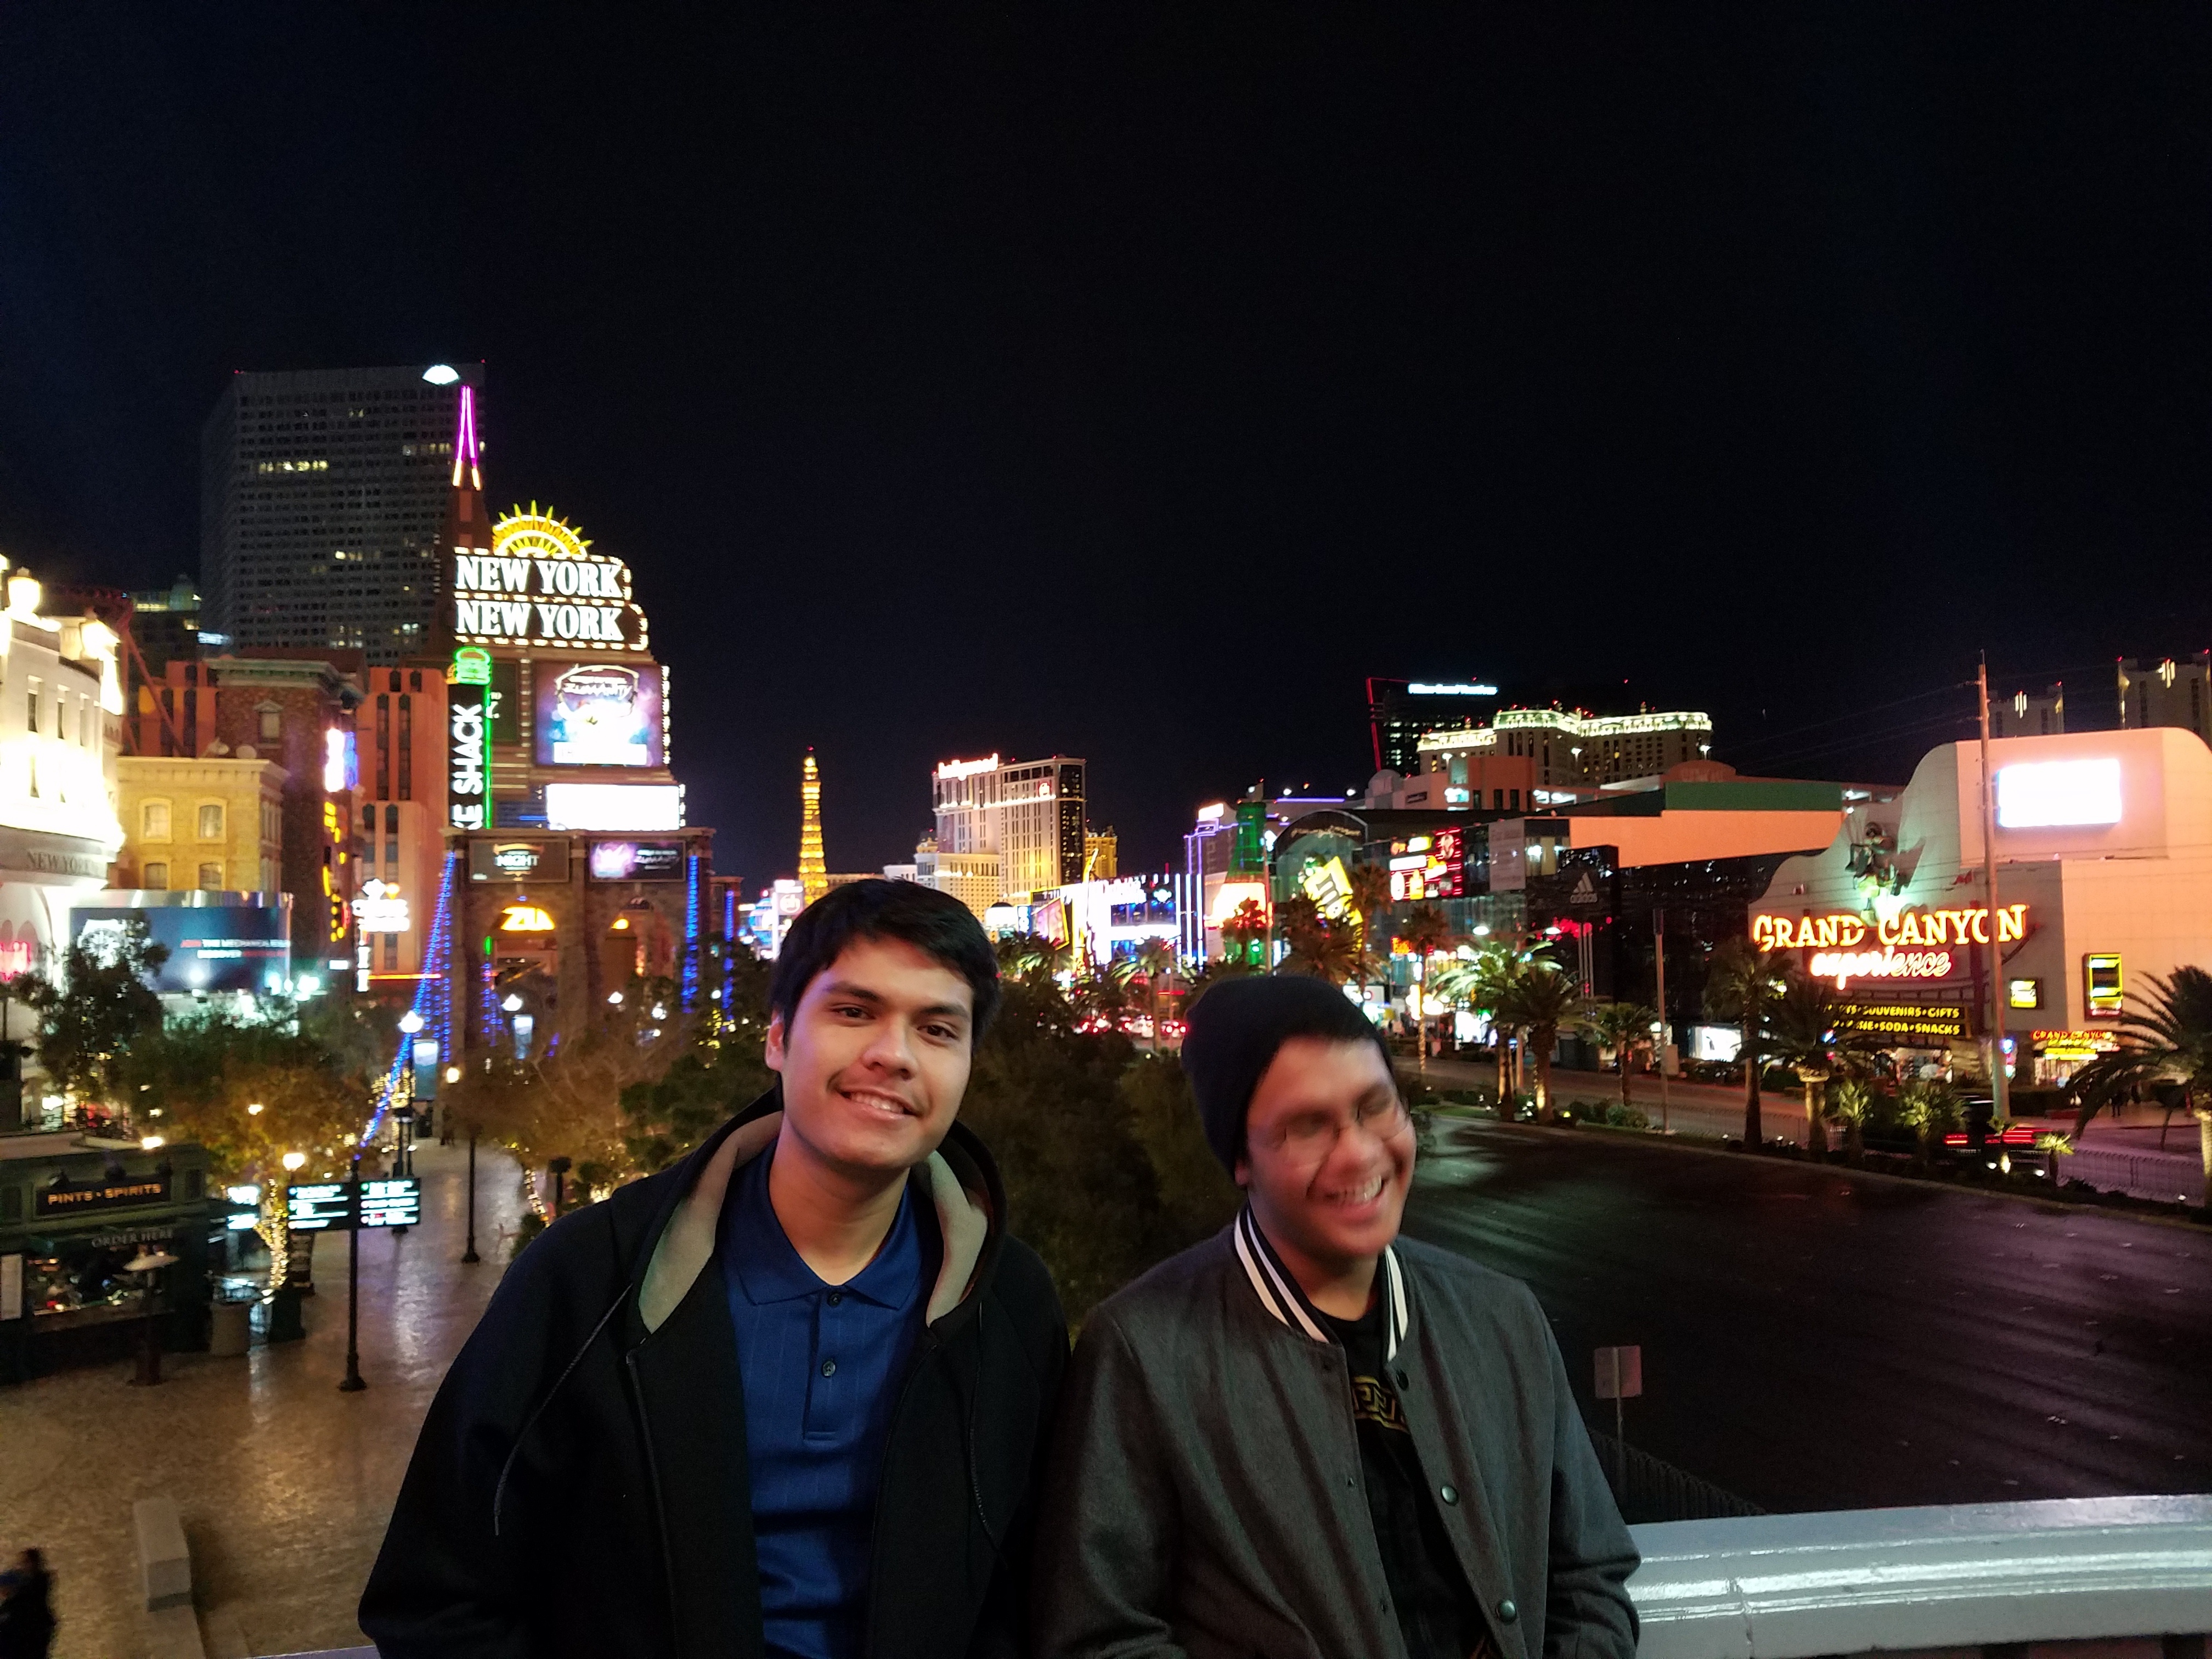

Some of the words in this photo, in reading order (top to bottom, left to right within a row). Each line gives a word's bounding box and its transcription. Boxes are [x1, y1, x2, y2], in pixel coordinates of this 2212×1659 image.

[456, 556, 531, 592] NEW
[535, 560, 623, 597] YORK
[455, 600, 532, 636] NEW
[535, 603, 625, 641] YORK
[452, 704, 483, 795] SHACK
[494, 855, 540, 867] NIGHT
[1753, 914, 1866, 952] GRAND
[1878, 904, 2028, 946] CANYON
[1879, 1021, 1909, 1032] SODA
[1915, 1023, 1960, 1035] SNACKS
[48, 1190, 93, 1205] PINTS
[104, 1183, 161, 1199] SPIRITS
